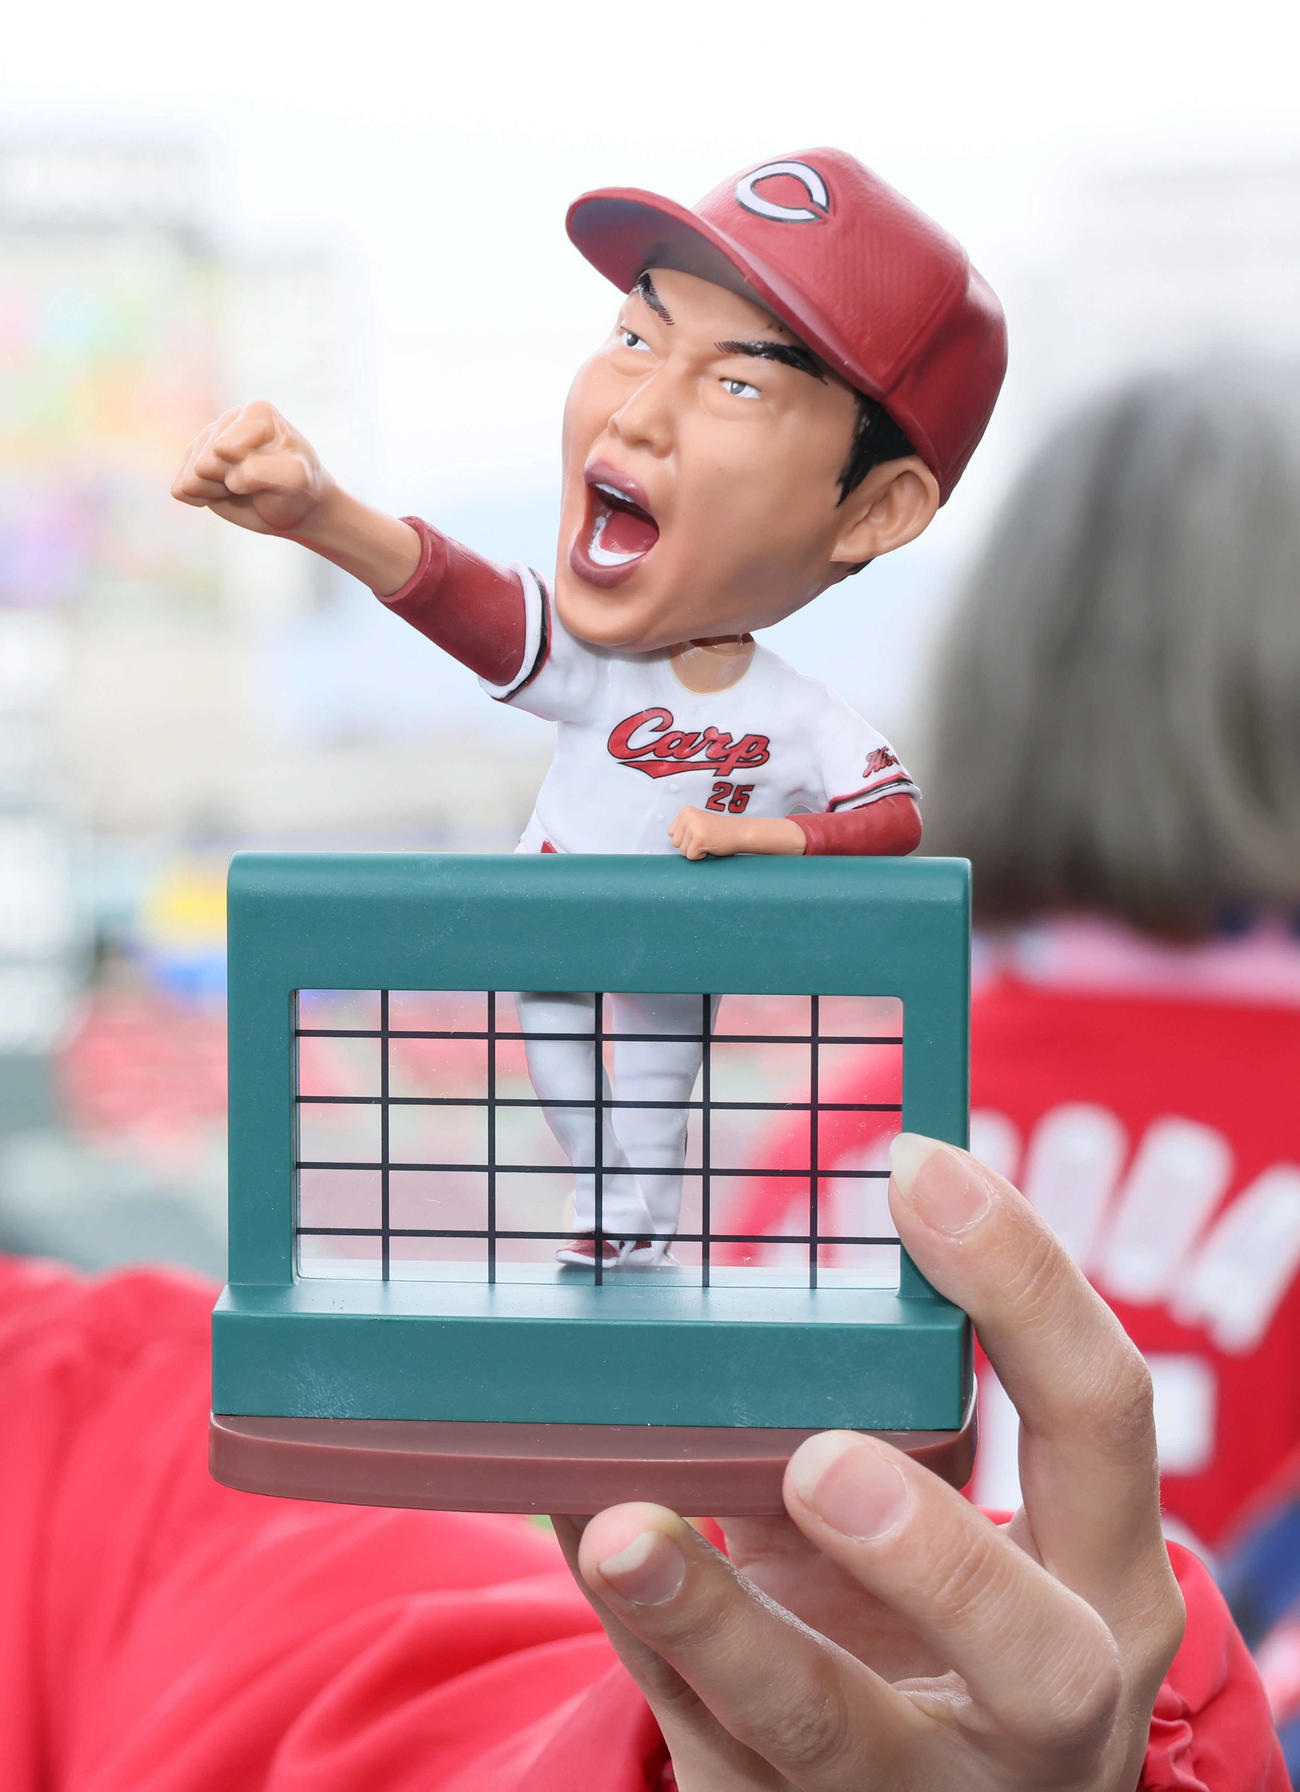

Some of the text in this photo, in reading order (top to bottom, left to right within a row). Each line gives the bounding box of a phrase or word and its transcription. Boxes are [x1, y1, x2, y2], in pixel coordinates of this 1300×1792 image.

[734, 160, 830, 223] C
[607, 706, 770, 779] Carp
[705, 781, 755, 813] 25
